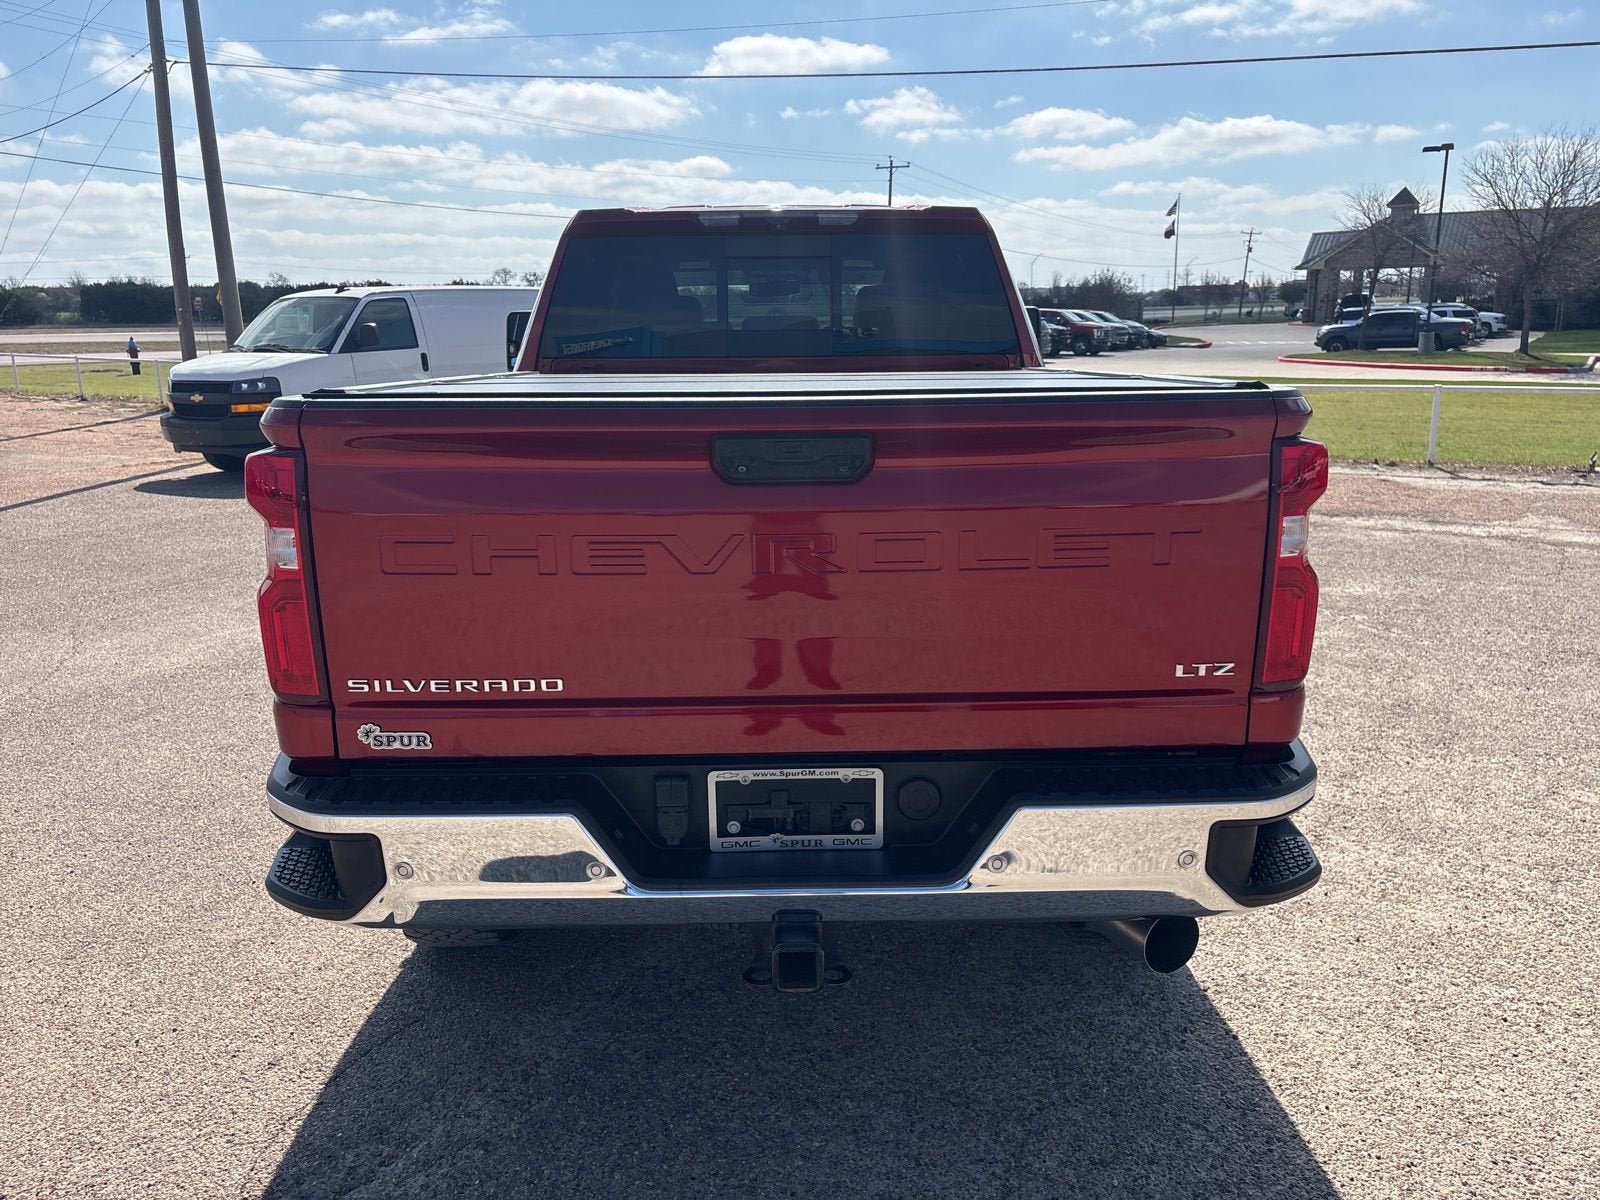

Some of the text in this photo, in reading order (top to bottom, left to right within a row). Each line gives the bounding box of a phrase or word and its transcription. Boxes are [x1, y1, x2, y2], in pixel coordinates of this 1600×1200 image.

[379, 528, 1202, 576] CHEVROLET
[1174, 662, 1236, 678] LTZ
[346, 678, 565, 693] SILVERADO
[373, 734, 430, 747] SPUR
[752, 770, 839, 778] www.SpurGM.com
[721, 838, 873, 848] GMC SPUR GMC
